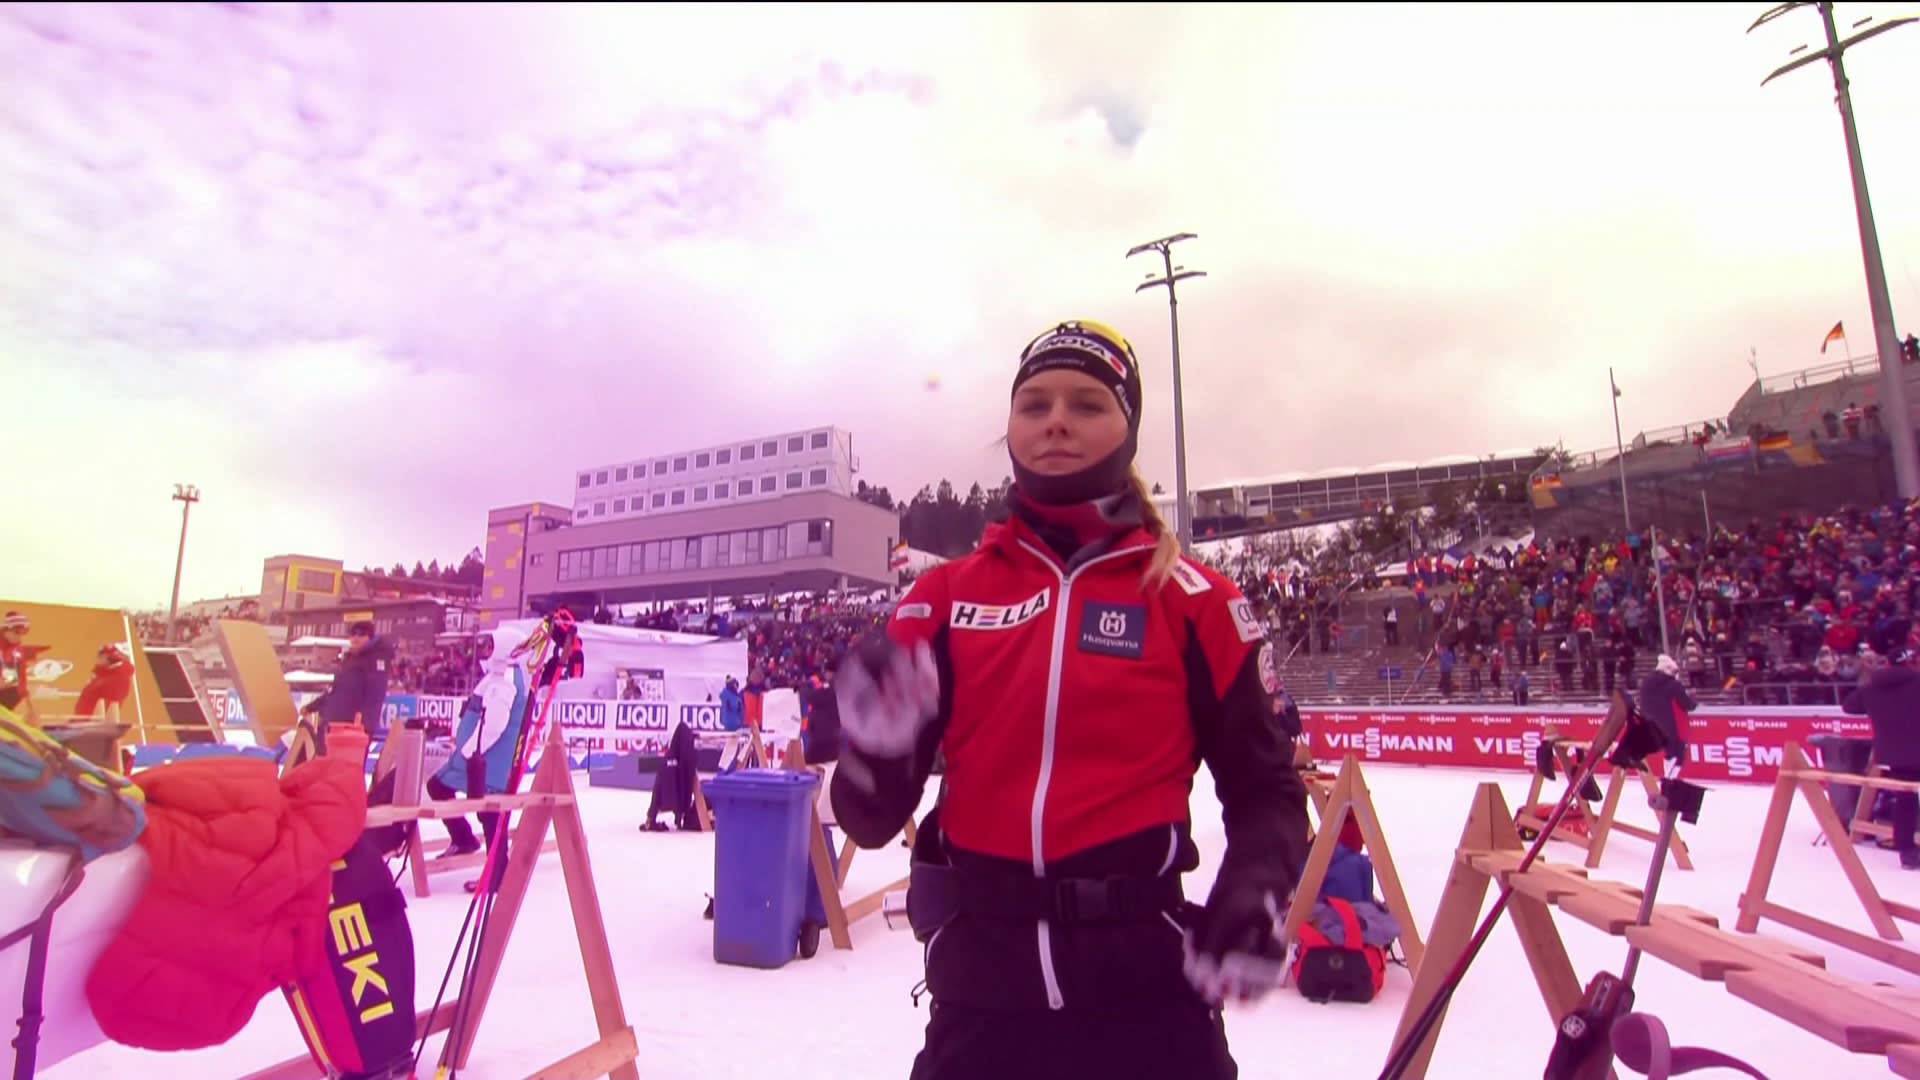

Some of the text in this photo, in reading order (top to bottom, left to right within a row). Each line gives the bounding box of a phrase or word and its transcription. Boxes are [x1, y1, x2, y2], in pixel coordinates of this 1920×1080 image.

[954, 592, 1046, 627] HELLA
[1082, 633, 1139, 649] Husqvarna
[420, 700, 452, 719] LIQUI
[561, 704, 604, 725] LIQUI
[617, 705, 667, 728] LIQUI
[1728, 719, 1788, 731] VIESSMANN
[1811, 720, 1870, 733] VIESSMAN
[1325, 727, 1453, 759] VIESSMANN
[329, 901, 394, 1025] EKI
